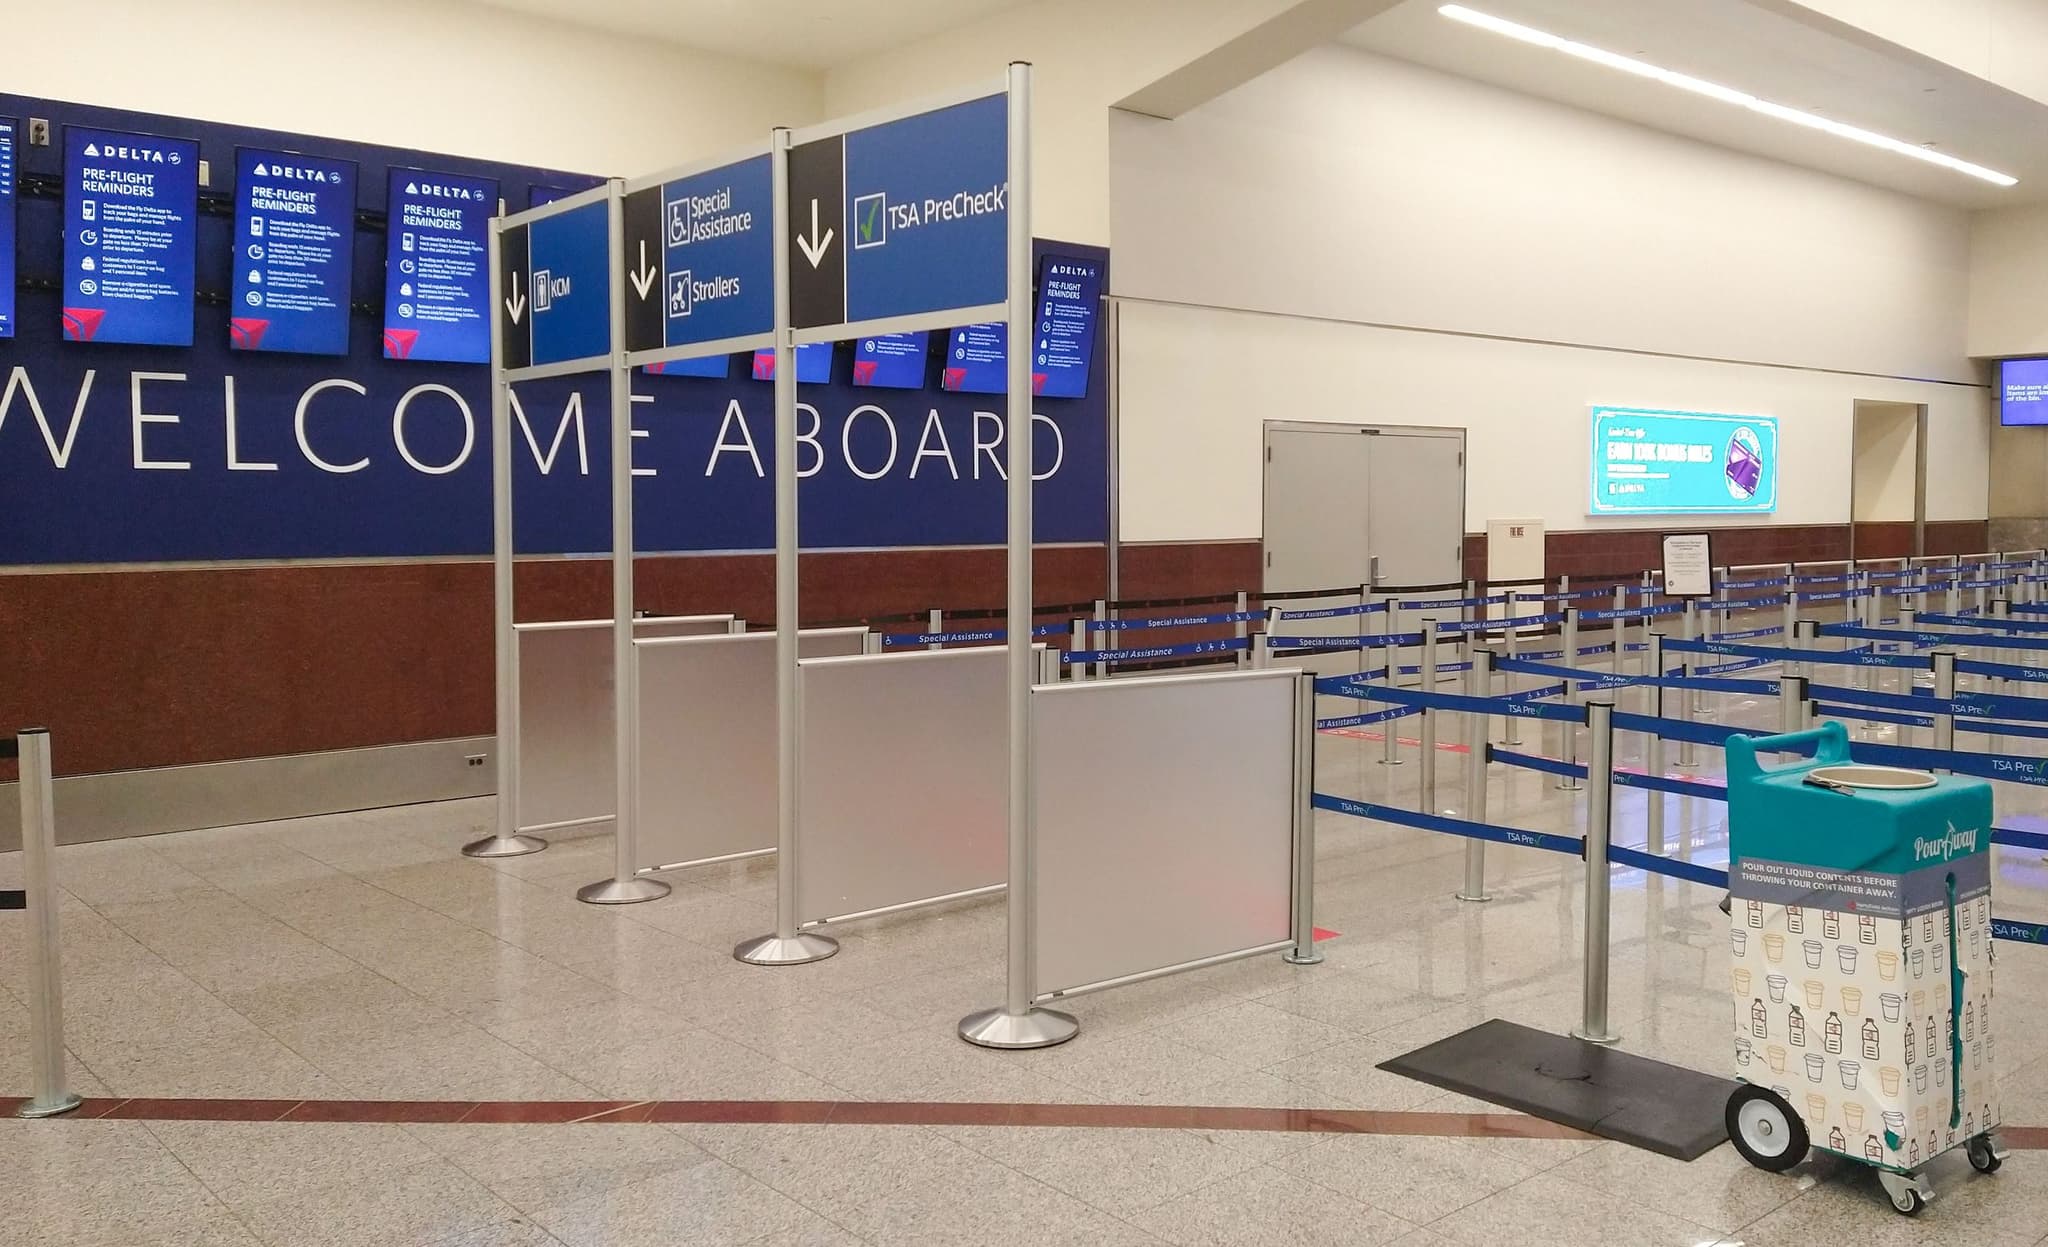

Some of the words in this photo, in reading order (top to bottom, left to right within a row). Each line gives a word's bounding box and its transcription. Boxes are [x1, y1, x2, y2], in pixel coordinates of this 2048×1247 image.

[104, 145, 163, 163] DELTA
[83, 167, 154, 185] PRE-FLIGHT
[272, 165, 326, 182] DELTA
[82, 180, 154, 197] REMINDERS
[252, 186, 316, 203] PRE-FLIGHT
[422, 184, 470, 200] DELTA
[252, 198, 317, 214] REMINDERS
[692, 187, 730, 218] Special
[404, 204, 462, 219] PRE-FLIGHT
[888, 201, 920, 231] TSA
[403, 215, 462, 230] REMINDERS
[692, 210, 752, 242] Assistance
[1060, 266, 1087, 276] DELTA
[550, 277, 570, 298] KCM
[693, 277, 740, 302] Strollers
[1048, 280, 1081, 291] PRE-FLIGHT
[1047, 289, 1080, 300] REMINDERS
[705, 399, 1063, 481] ABOARD
[1148, 618, 1172, 628] Special
[1174, 616, 1207, 626] Assistance
[1283, 610, 1302, 620] Special
[1304, 610, 1334, 618] Assistance
[1460, 621, 1480, 630] Special
[1482, 619, 1511, 628] Assistance
[919, 632, 947, 644] Special
[949, 630, 993, 642] Assistance
[1299, 638, 1323, 647] Special
[1324, 637, 1360, 646] Assistance
[1098, 649, 1125, 662] Special
[1127, 646, 1172, 659] Assistance
[2023, 670, 2037, 678] TSA
[1341, 686, 1352, 695] TSA
[1354, 688, 1364, 697] Pre
[1509, 704, 1521, 713] TSA
[1523, 706, 1535, 715] Pre
[1950, 704, 1966, 713] TSA
[1968, 706, 1982, 714] Pre
[1326, 716, 1361, 727] Assistance
[1992, 759, 2013, 771] TSA
[2015, 761, 2034, 772] Pre
[1614, 774, 1625, 783] Pre
[1341, 802, 1352, 812] TSA
[1353, 804, 1364, 814] Pre
[1506, 832, 1520, 842] TSA
[1522, 834, 1534, 844] Pre
[1914, 820, 1979, 861] PourAway
[1743, 862, 1765, 872] POUR
[1766, 866, 1783, 874] OUT
[1786, 867, 1814, 878] LIQUID
[1816, 871, 1861, 883] CONTENTS
[1864, 877, 1897, 888] BEFORE
[1742, 873, 1785, 885] THROWING
[1787, 878, 1811, 888] YOUR
[1813, 882, 1864, 894] CONTAINER
[1866, 887, 1897, 898] AWAY.
[1992, 924, 2008, 935] SA
[2011, 926, 2029, 938] Pre
